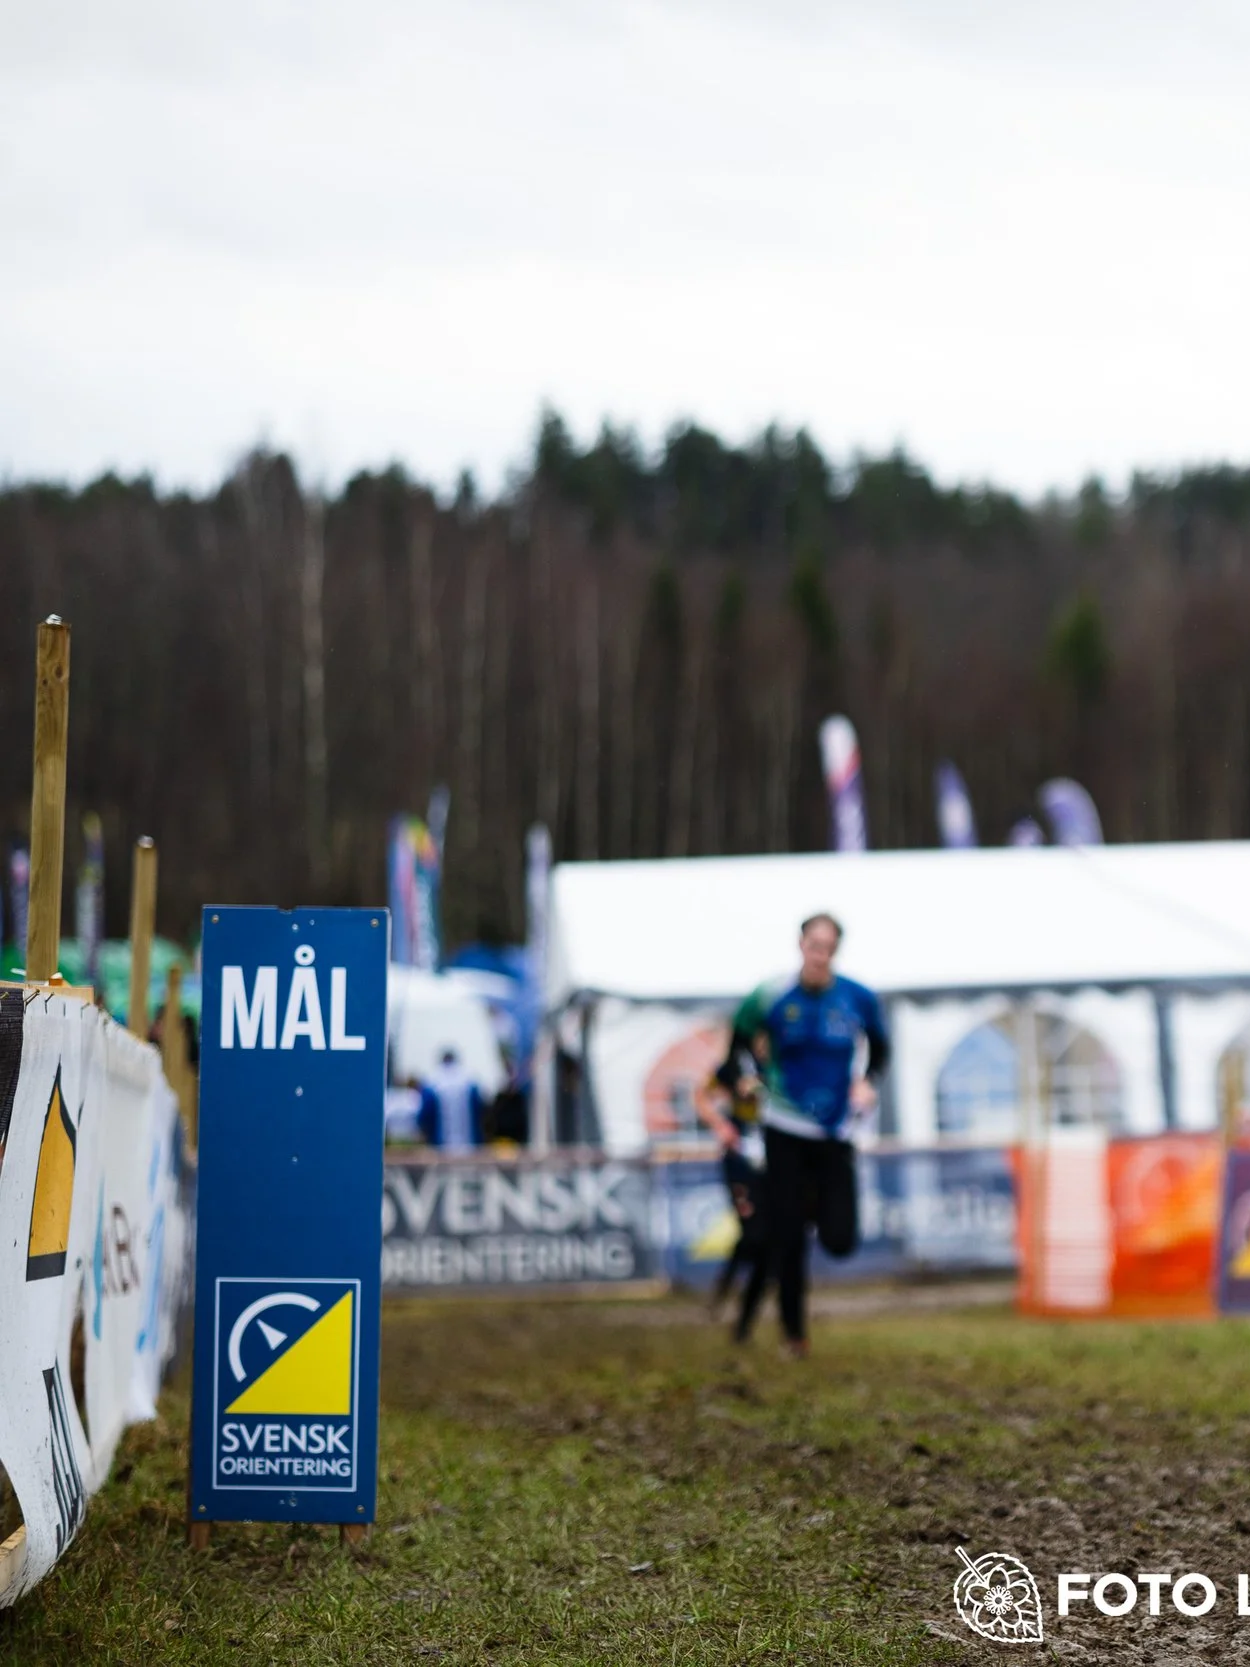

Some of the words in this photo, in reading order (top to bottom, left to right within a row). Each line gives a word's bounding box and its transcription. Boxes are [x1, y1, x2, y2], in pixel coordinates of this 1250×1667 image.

[220, 944, 367, 1051] MÅL
[221, 1422, 351, 1454] SVENSK
[219, 1455, 352, 1478] ORIENTERING
